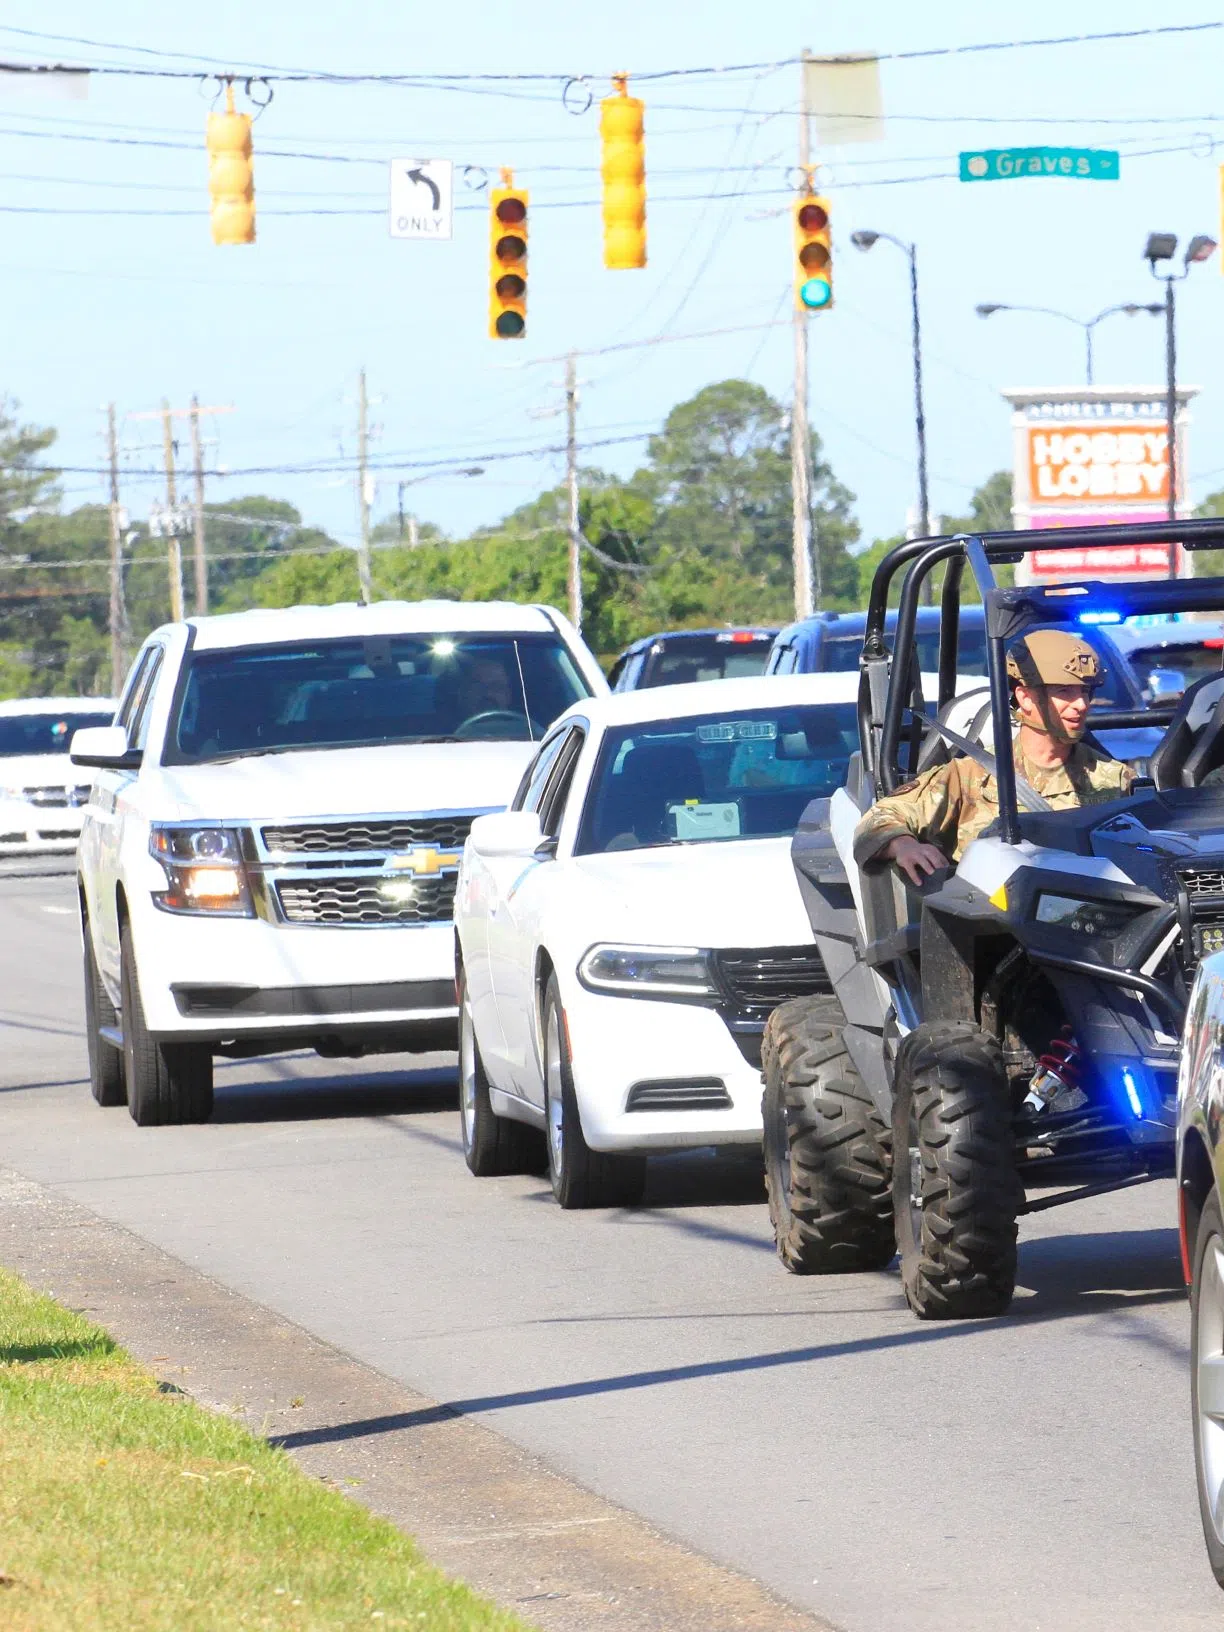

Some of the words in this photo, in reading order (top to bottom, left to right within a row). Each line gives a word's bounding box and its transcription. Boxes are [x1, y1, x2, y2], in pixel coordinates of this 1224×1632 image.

[996, 153, 1091, 176] Graves
[397, 216, 443, 232] ONLY
[1033, 432, 1168, 465] HOBBY
[1038, 464, 1168, 497] LOBBY
